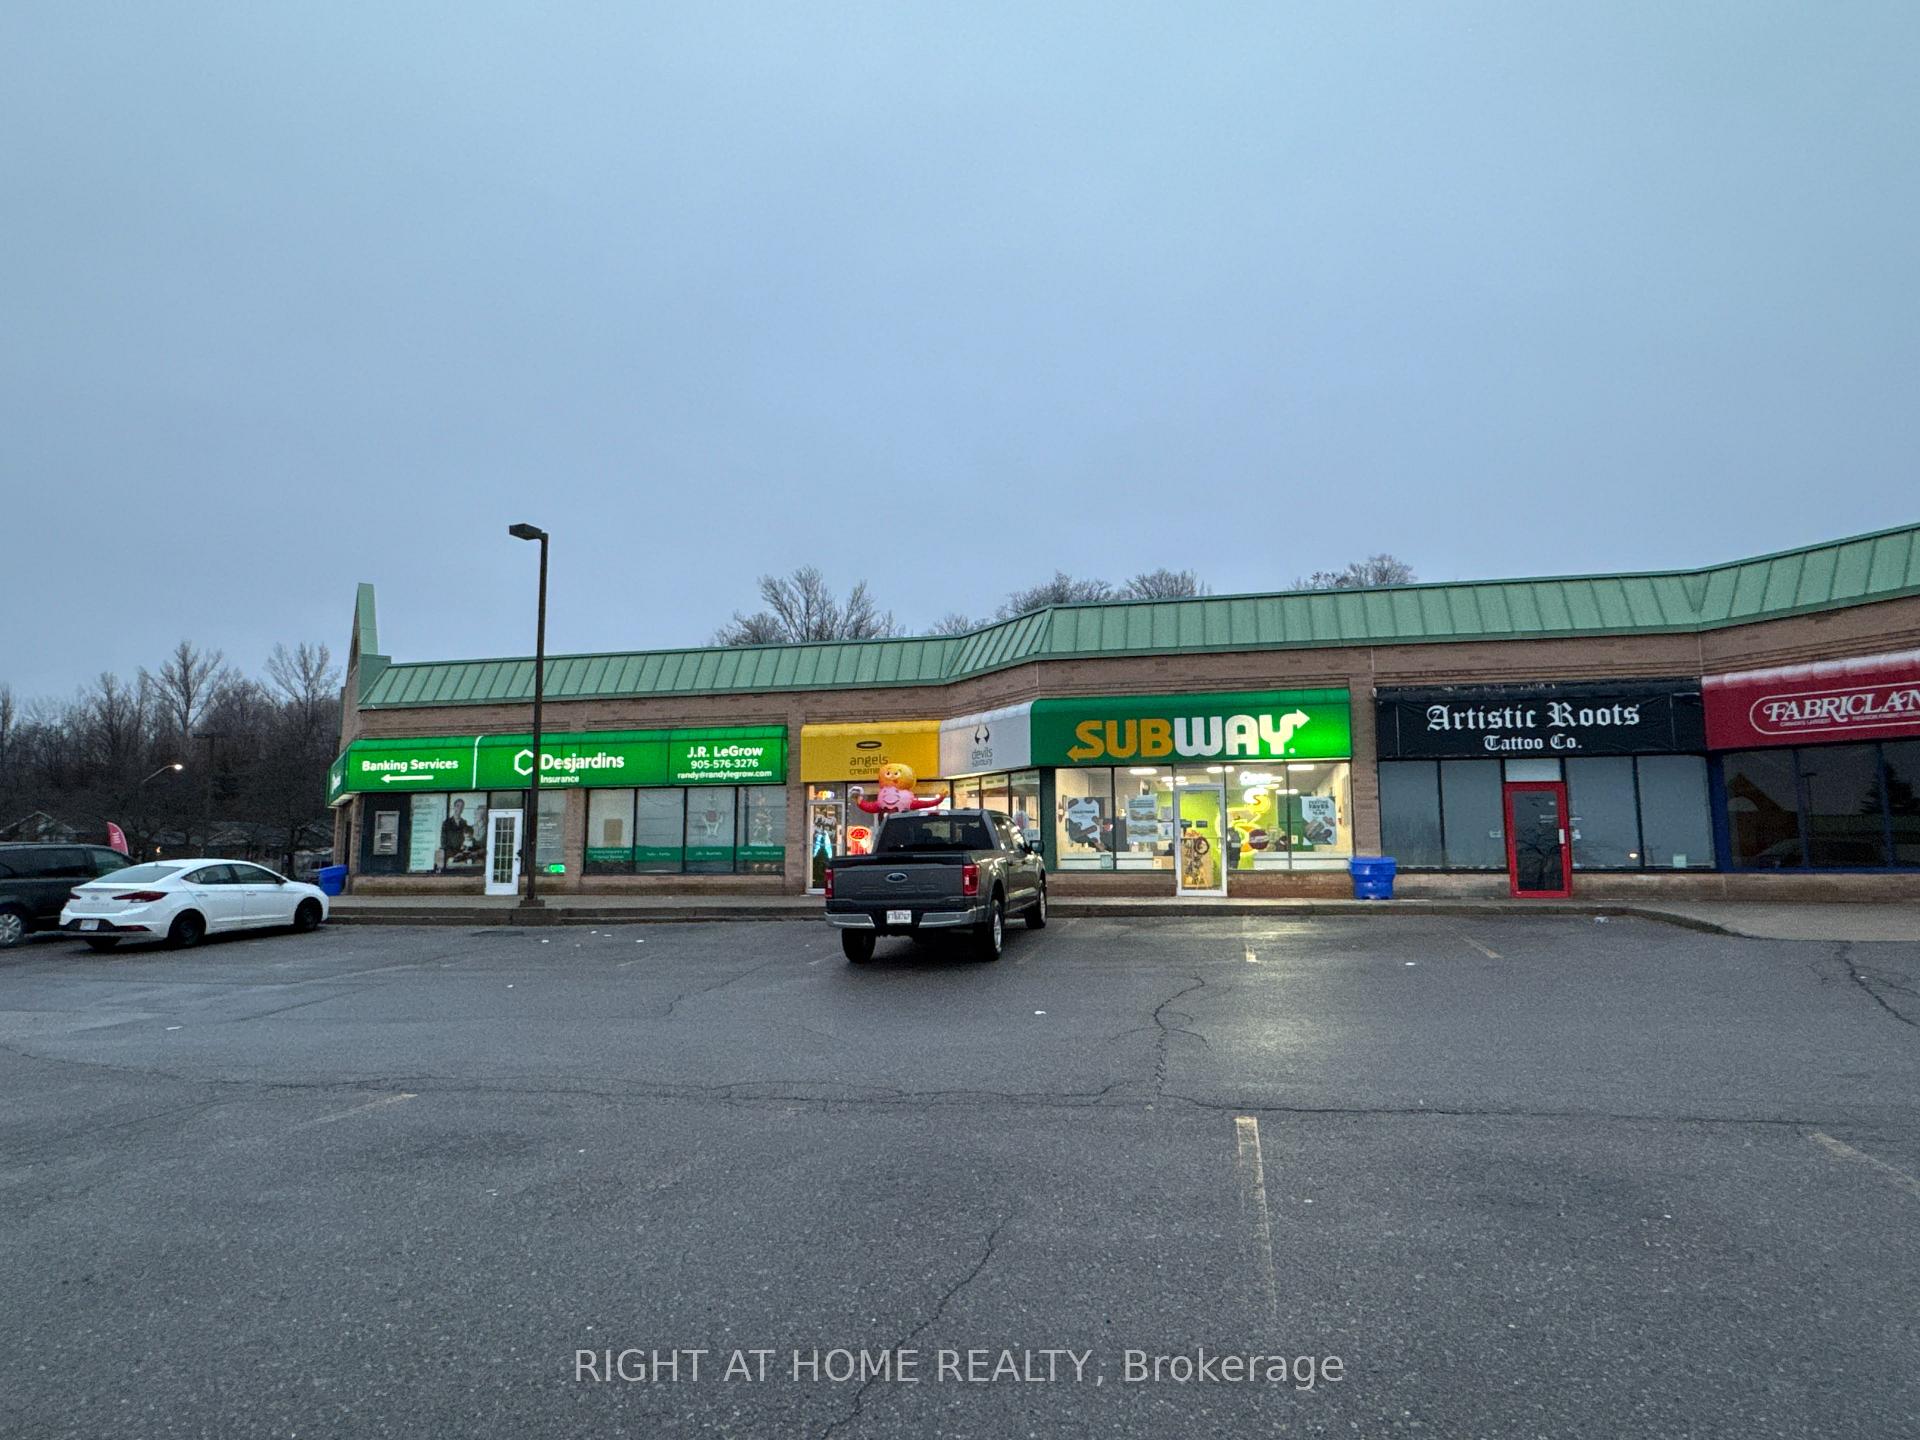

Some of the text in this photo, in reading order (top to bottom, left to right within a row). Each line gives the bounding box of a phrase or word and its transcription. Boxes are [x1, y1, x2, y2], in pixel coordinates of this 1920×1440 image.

[1426, 702, 1640, 731] Artistic Roots
[1067, 709, 1310, 761] SUBWAY
[1483, 733, 1582, 751] Tattoo Co.
[687, 745, 763, 758] J.R. LeGrow
[362, 758, 459, 772] Banking Services
[540, 752, 625, 773] Desjardins
[690, 759, 759, 769] 905-576-3276
[849, 754, 889, 768] angels
[540, 774, 580, 783] Insurance
[677, 770, 772, 780] randy@randylegrow.com
